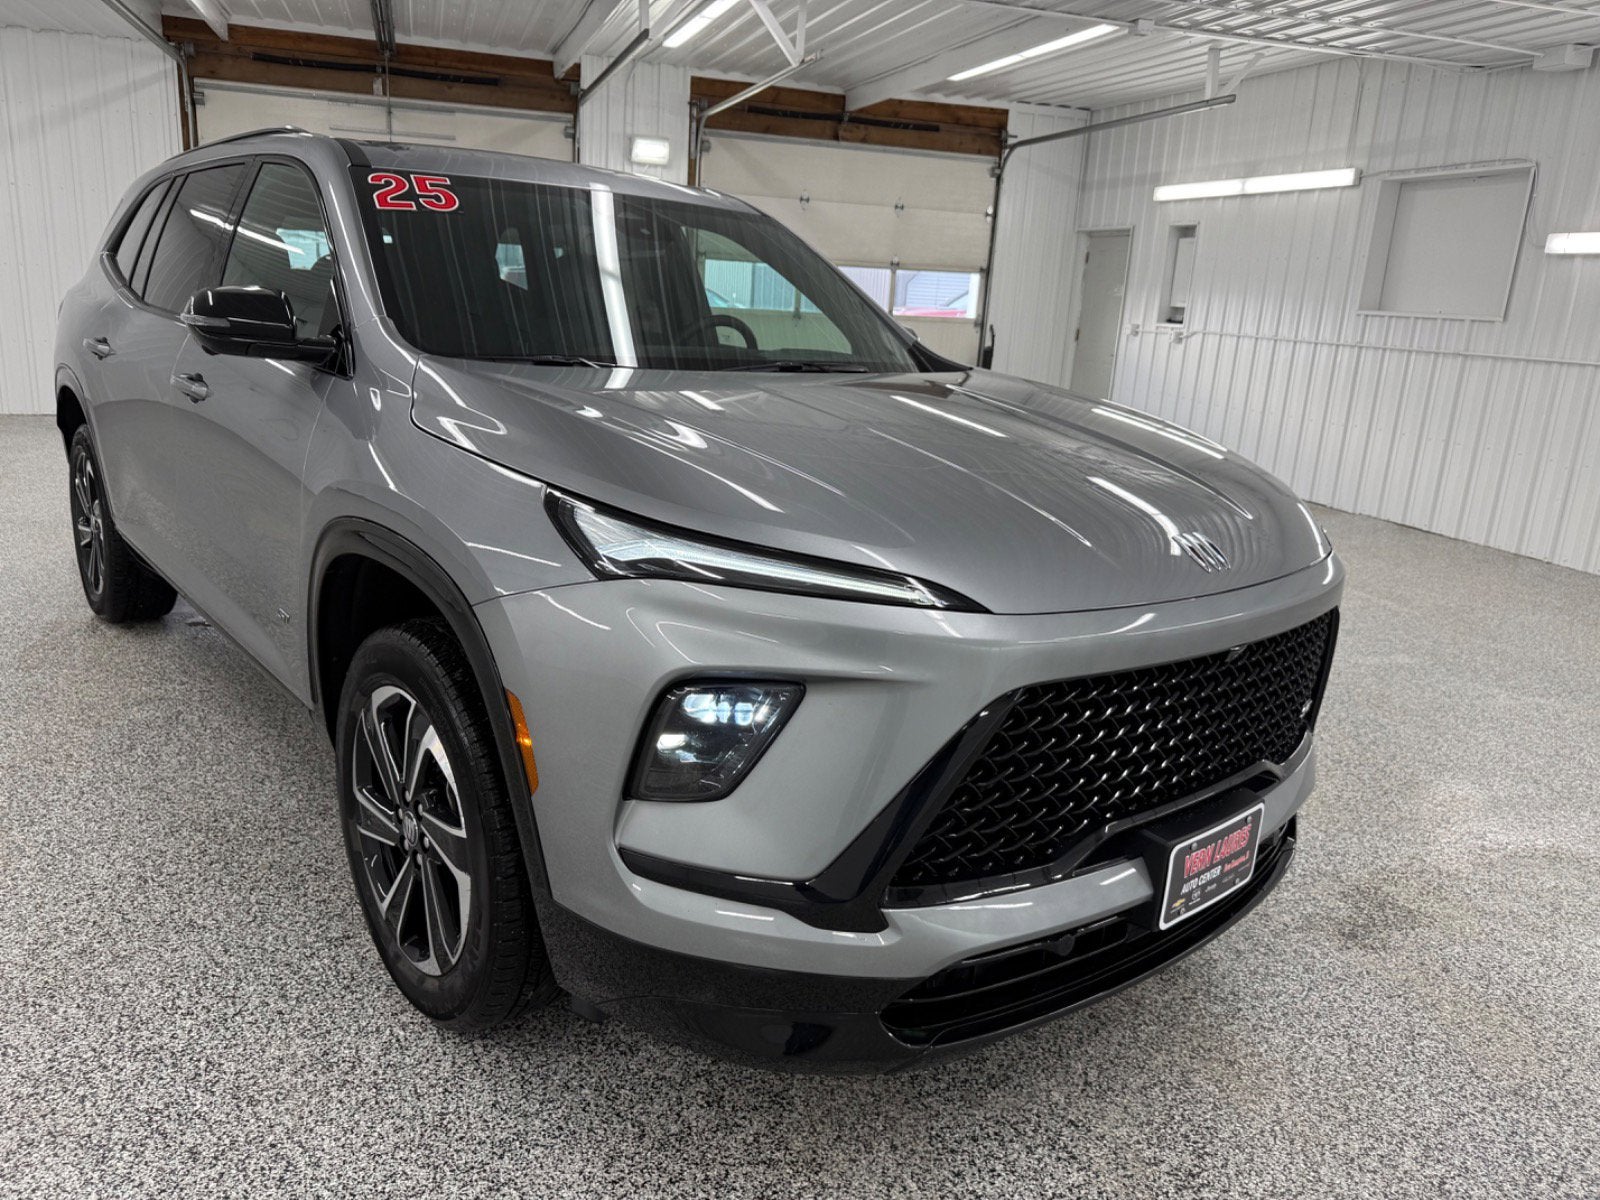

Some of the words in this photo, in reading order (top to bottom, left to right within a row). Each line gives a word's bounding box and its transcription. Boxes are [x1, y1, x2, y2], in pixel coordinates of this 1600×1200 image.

[367, 172, 459, 212] 25
[1184, 843, 1215, 878] VERN
[1180, 877, 1199, 896] AUTO
[1198, 865, 1223, 886] CENTER
